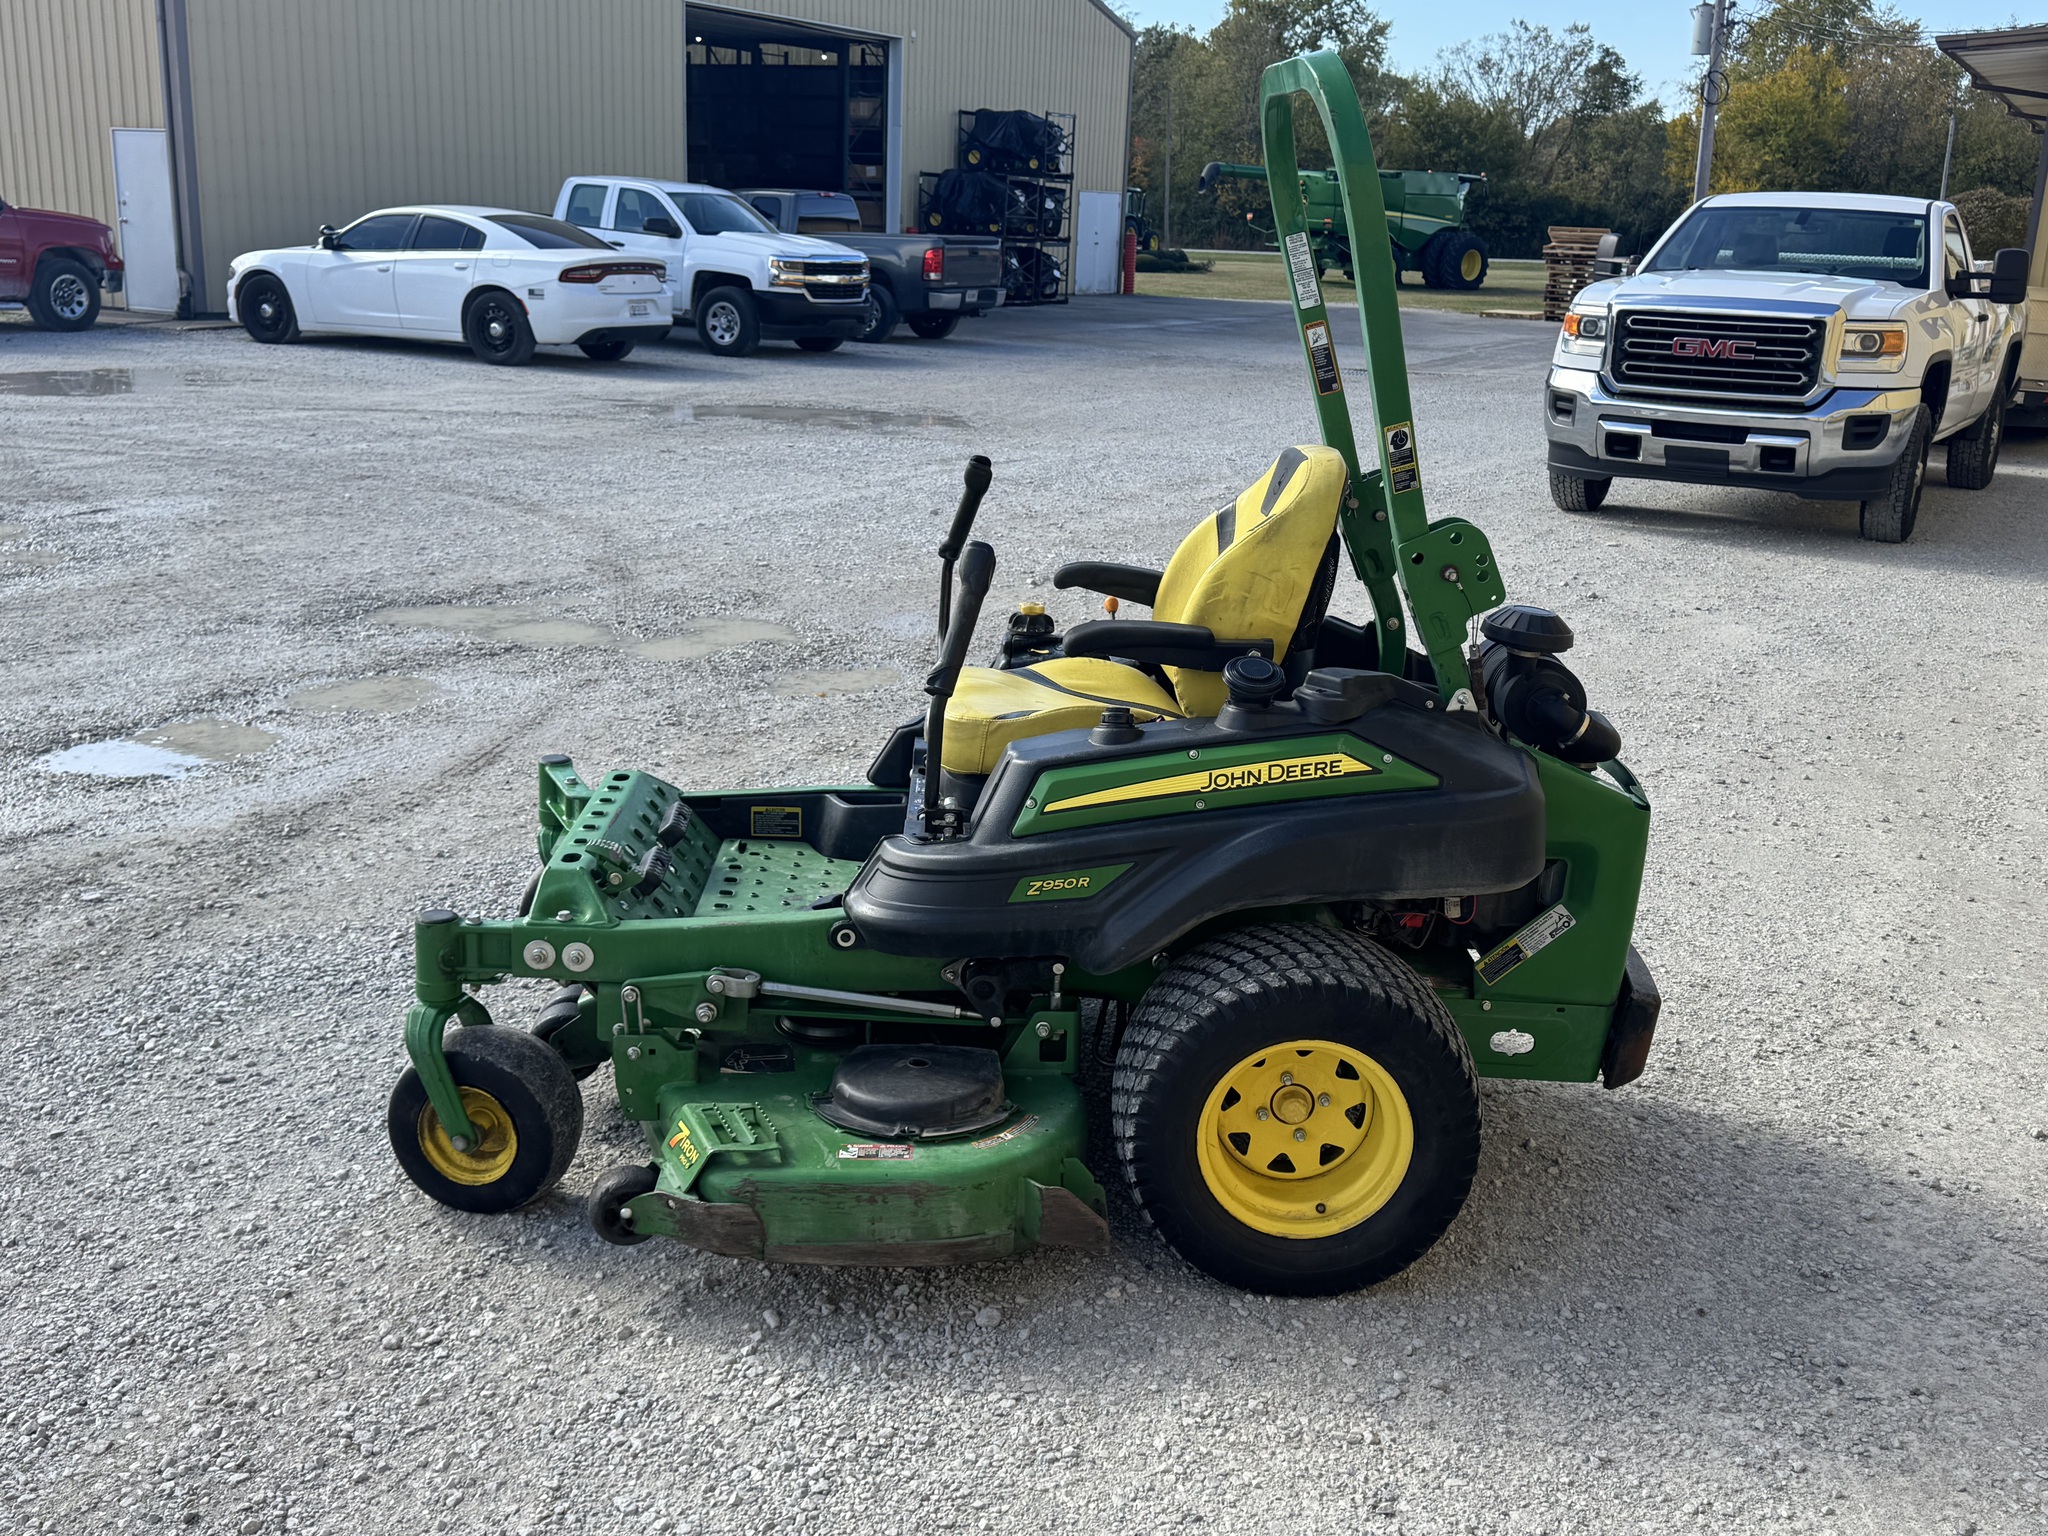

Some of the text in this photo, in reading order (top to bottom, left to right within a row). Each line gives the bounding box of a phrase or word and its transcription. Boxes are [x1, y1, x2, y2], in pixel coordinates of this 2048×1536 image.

[1672, 337, 1756, 360] GMC
[1200, 760, 1342, 790] JOHN DEERE
[1027, 877, 1090, 896] Z950R
[669, 1120, 700, 1164] 7 IRON
